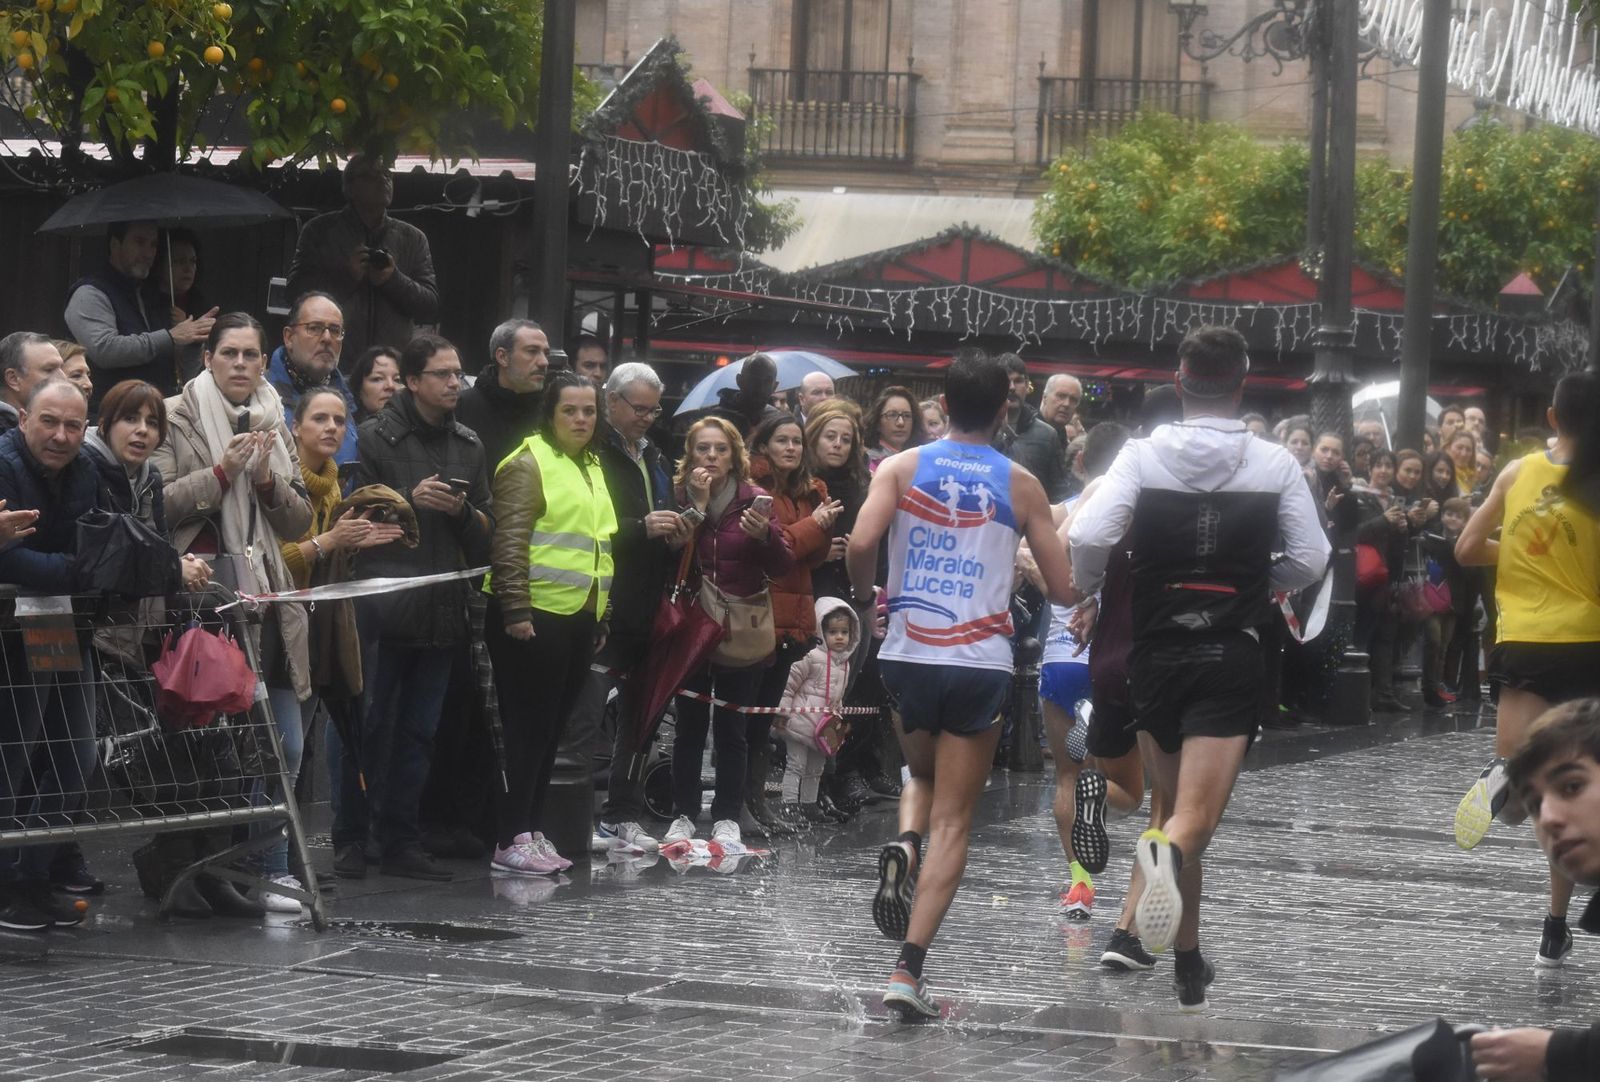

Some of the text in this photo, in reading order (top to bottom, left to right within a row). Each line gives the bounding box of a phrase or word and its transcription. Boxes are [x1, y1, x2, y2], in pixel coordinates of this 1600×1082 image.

[934, 456, 993, 473] enerplus
[908, 526, 957, 551] Club
[905, 549, 984, 580] Maratón
[903, 570, 974, 599] Lucena
